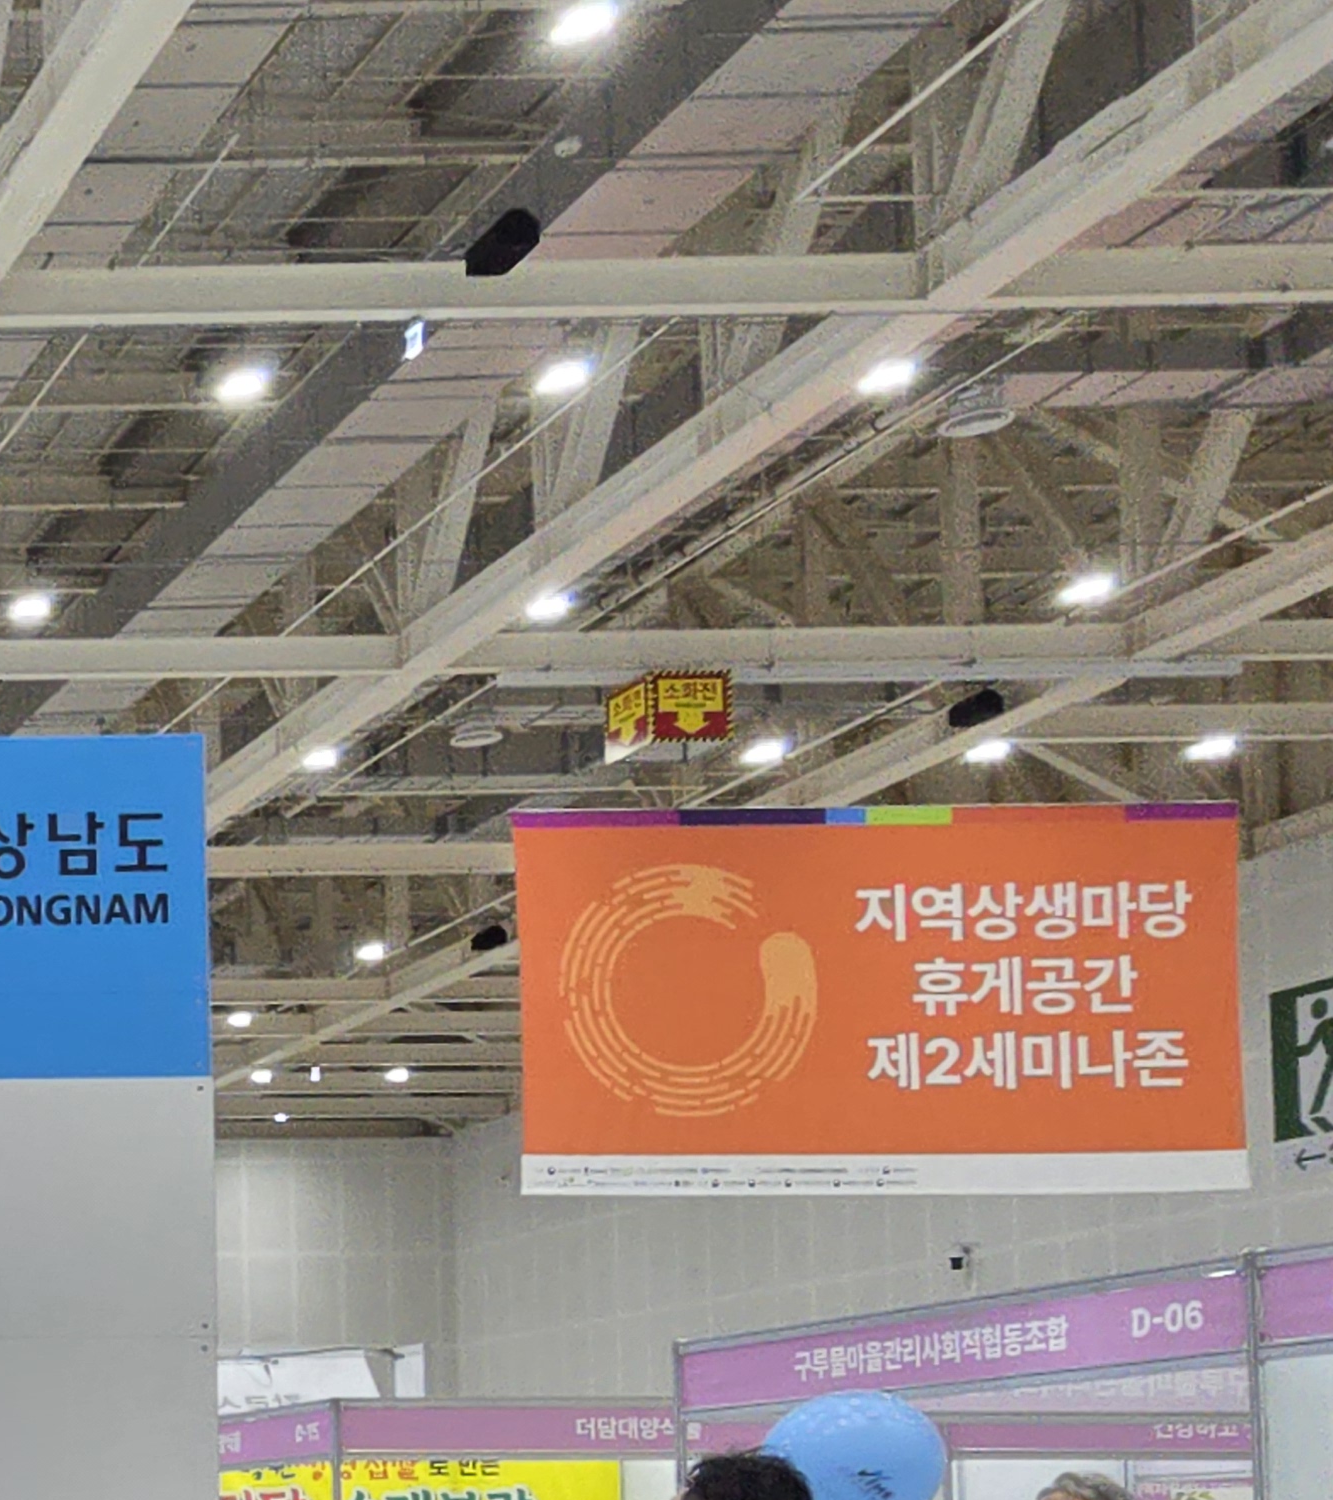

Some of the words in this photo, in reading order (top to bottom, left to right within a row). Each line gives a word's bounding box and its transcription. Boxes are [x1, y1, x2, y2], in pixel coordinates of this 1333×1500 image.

[855, 880, 1193, 942] 지역상생마당
[912, 954, 1138, 1016] 휴게공간
[867, 1029, 1189, 1090] 제2세미나존
[1131, 1300, 1203, 1338] D-06
